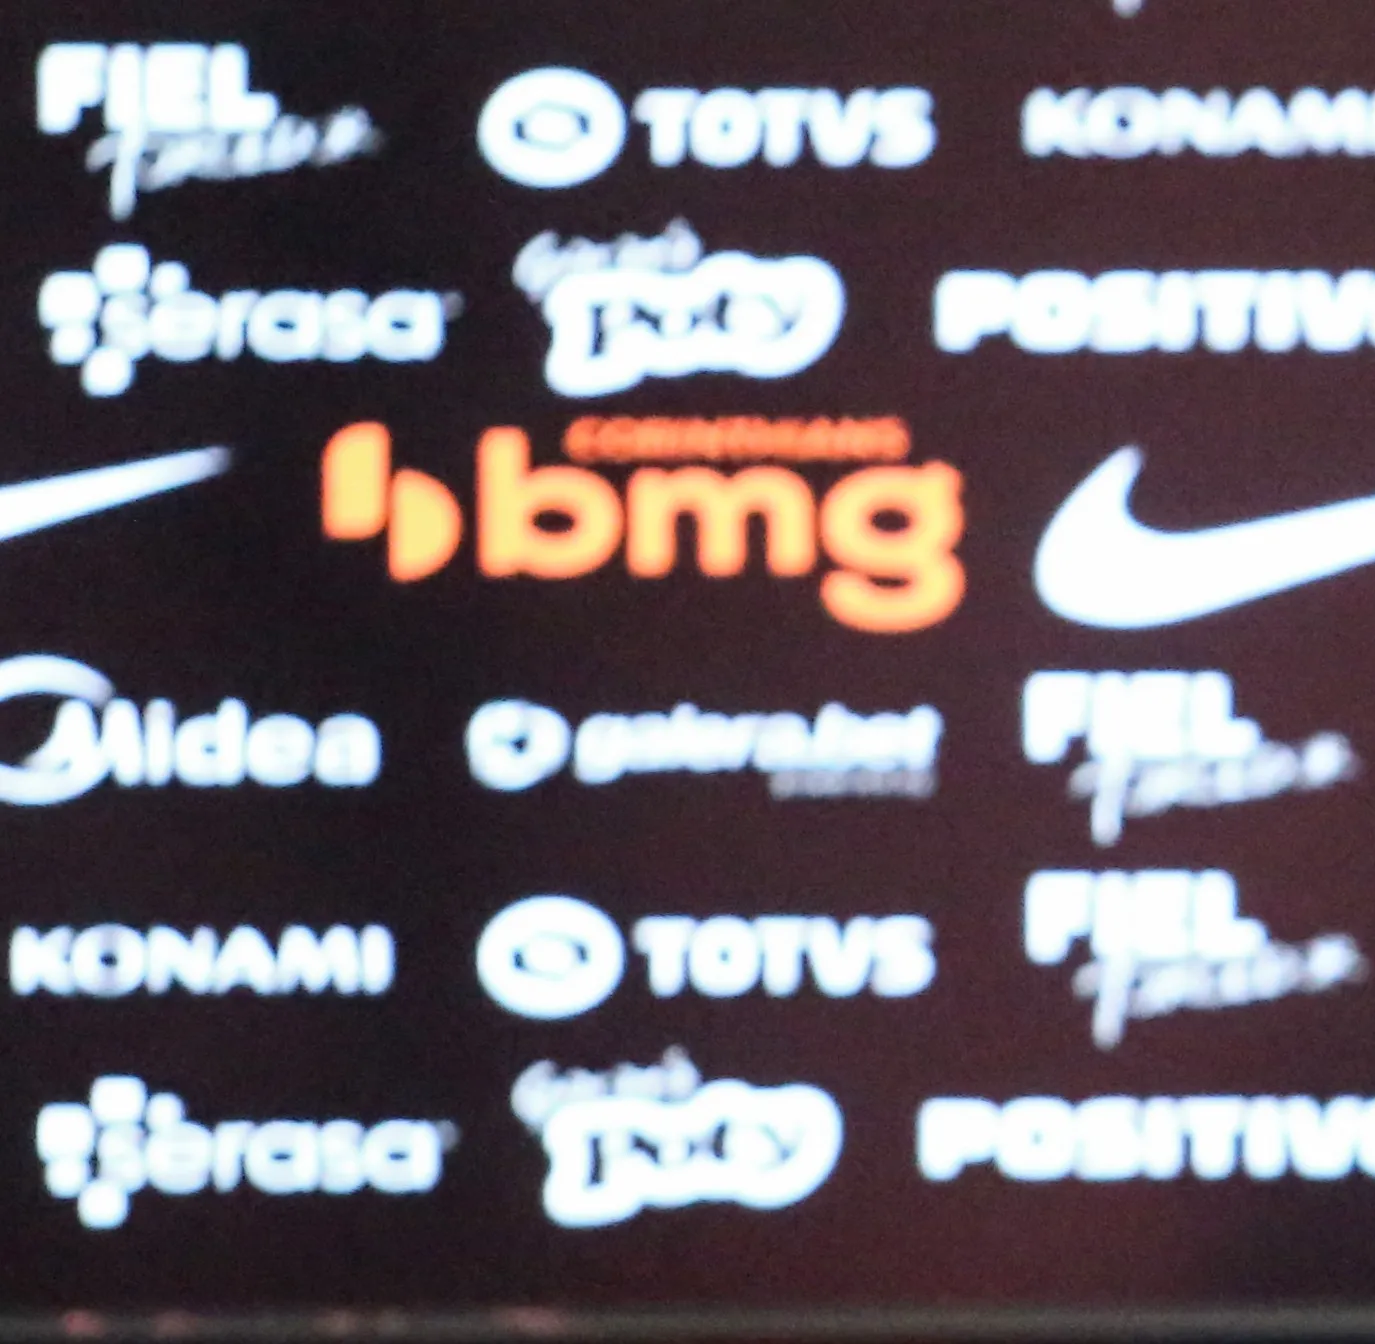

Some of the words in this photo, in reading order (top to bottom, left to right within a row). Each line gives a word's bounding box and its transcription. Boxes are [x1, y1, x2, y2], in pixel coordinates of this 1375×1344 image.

[37, 42, 280, 133] FIEL
[631, 86, 938, 169] TOTVS
[103, 288, 446, 363] serasa
[476, 425, 967, 634] bmg
[48, 697, 382, 788] Midea
[1021, 668, 1270, 762] FIEL
[632, 914, 937, 998] TOTVS
[1022, 868, 1270, 963] FIEL
[9, 923, 396, 997] KONAMI
[97, 1119, 443, 1194] serasa
